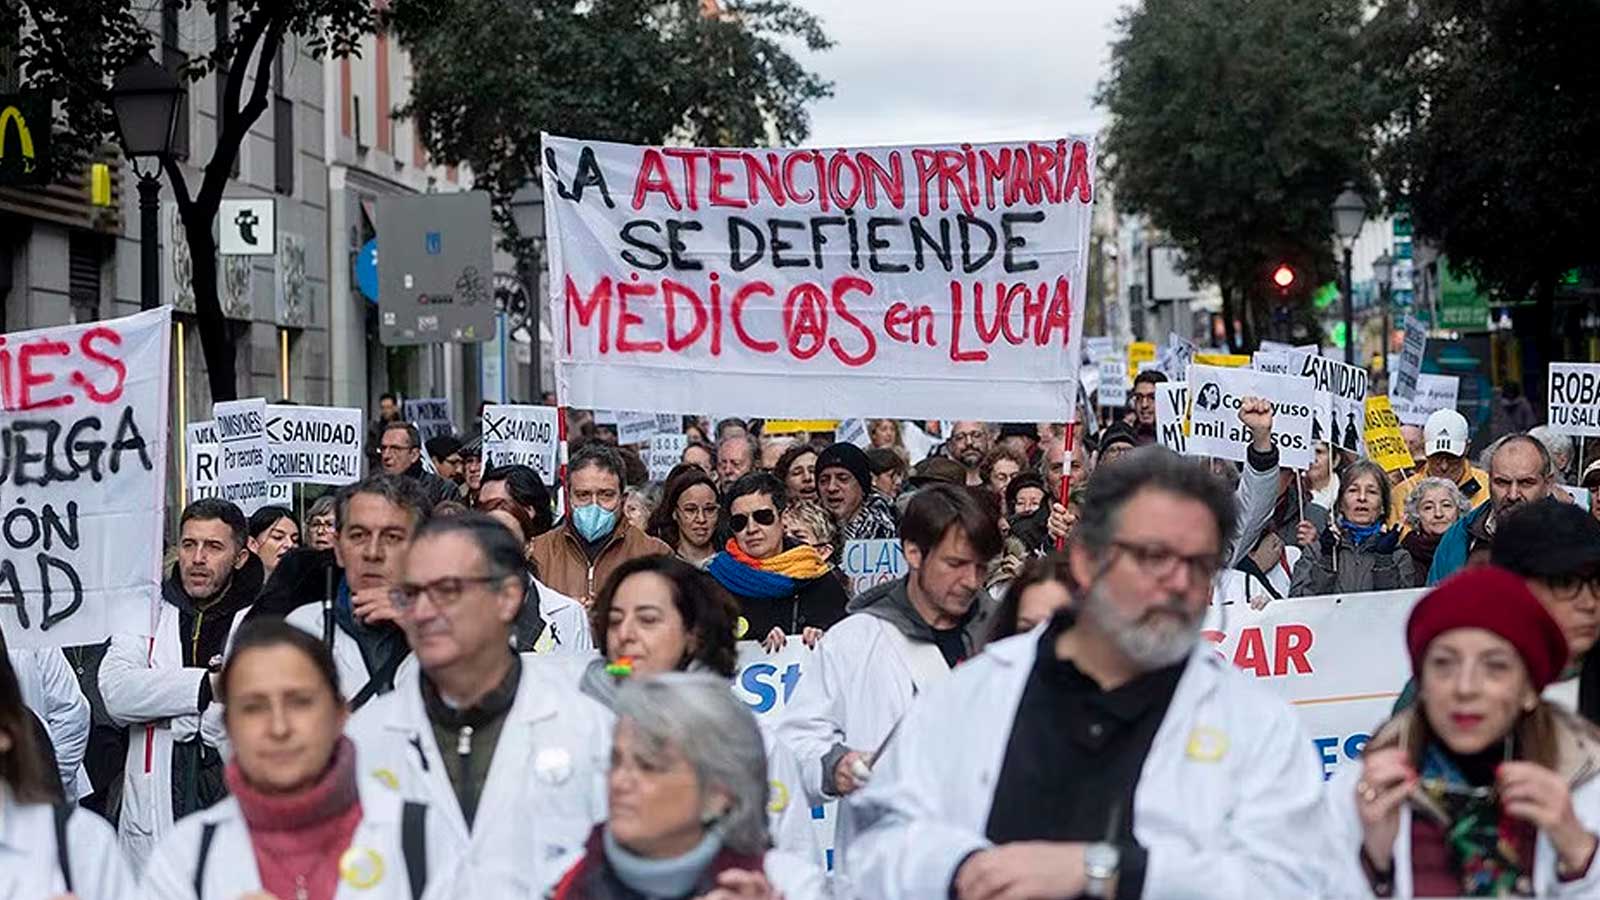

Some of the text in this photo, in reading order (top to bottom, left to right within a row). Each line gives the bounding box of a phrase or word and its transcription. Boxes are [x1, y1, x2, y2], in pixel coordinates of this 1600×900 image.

[546, 146, 615, 208] LA
[912, 138, 1092, 217] PRIMARIA
[620, 208, 1046, 274] SE DEFIENDE
[884, 301, 937, 347] en
[950, 275, 1070, 362] LUCHA
[1312, 356, 1366, 401] SANIDAD
[283, 420, 359, 449] SANIDAD,
[1195, 420, 1308, 450] mil absos.
[1551, 406, 1600, 427] TU SAL
